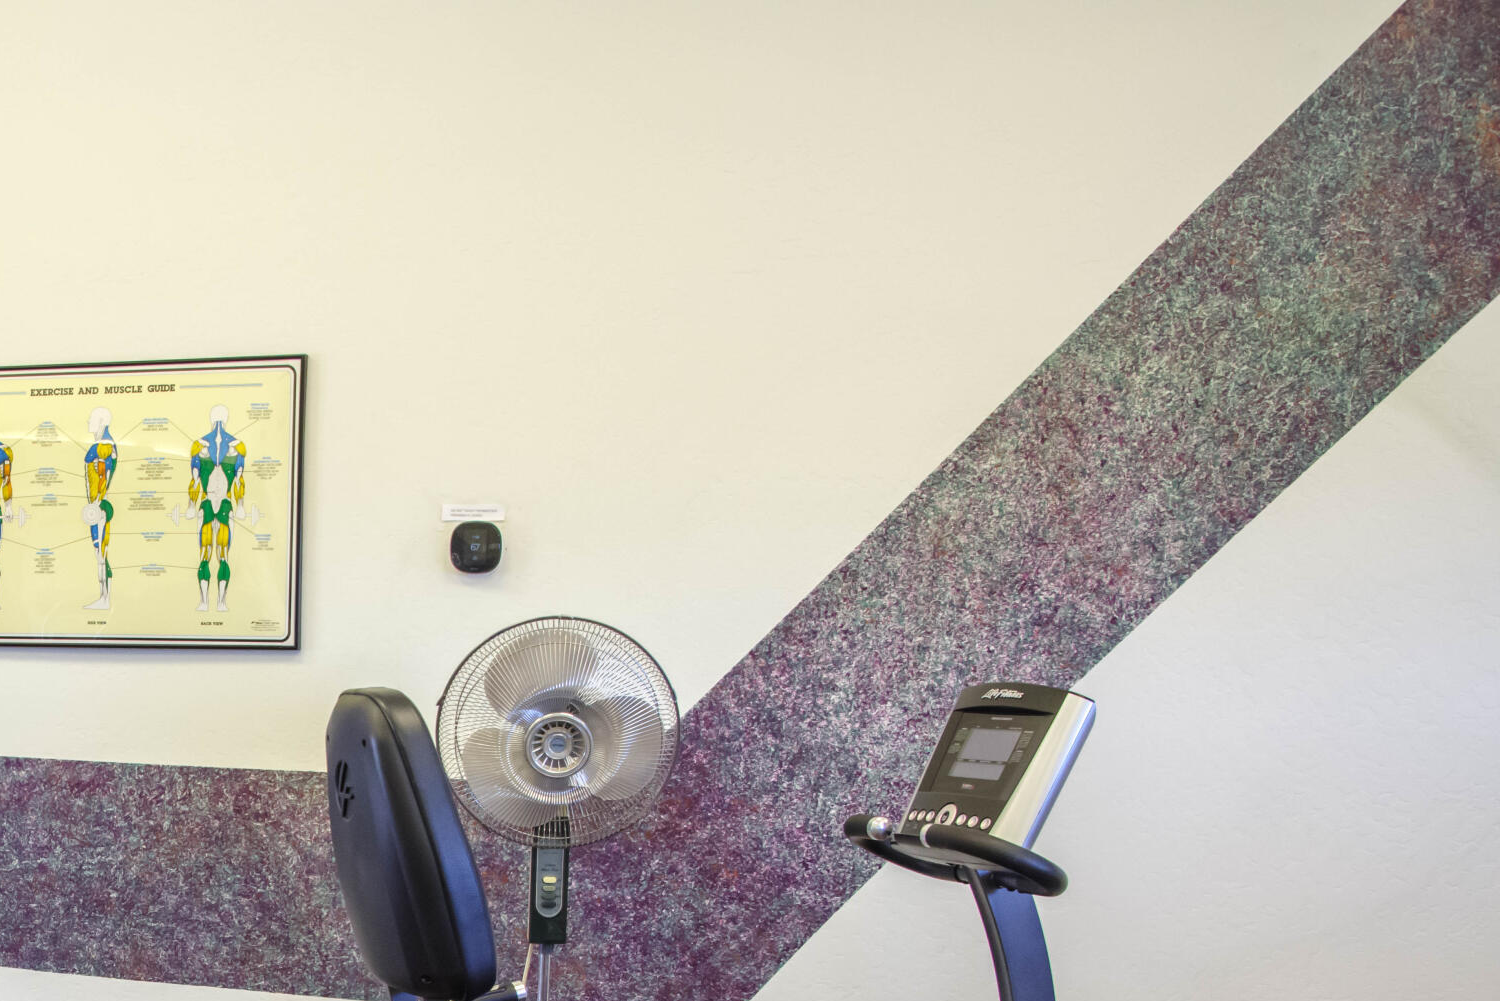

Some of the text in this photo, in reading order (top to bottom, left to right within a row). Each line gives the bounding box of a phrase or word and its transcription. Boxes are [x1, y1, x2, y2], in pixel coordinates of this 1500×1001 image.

[30, 383, 176, 397] EXERCISE AND MUSCLE GUIDE
